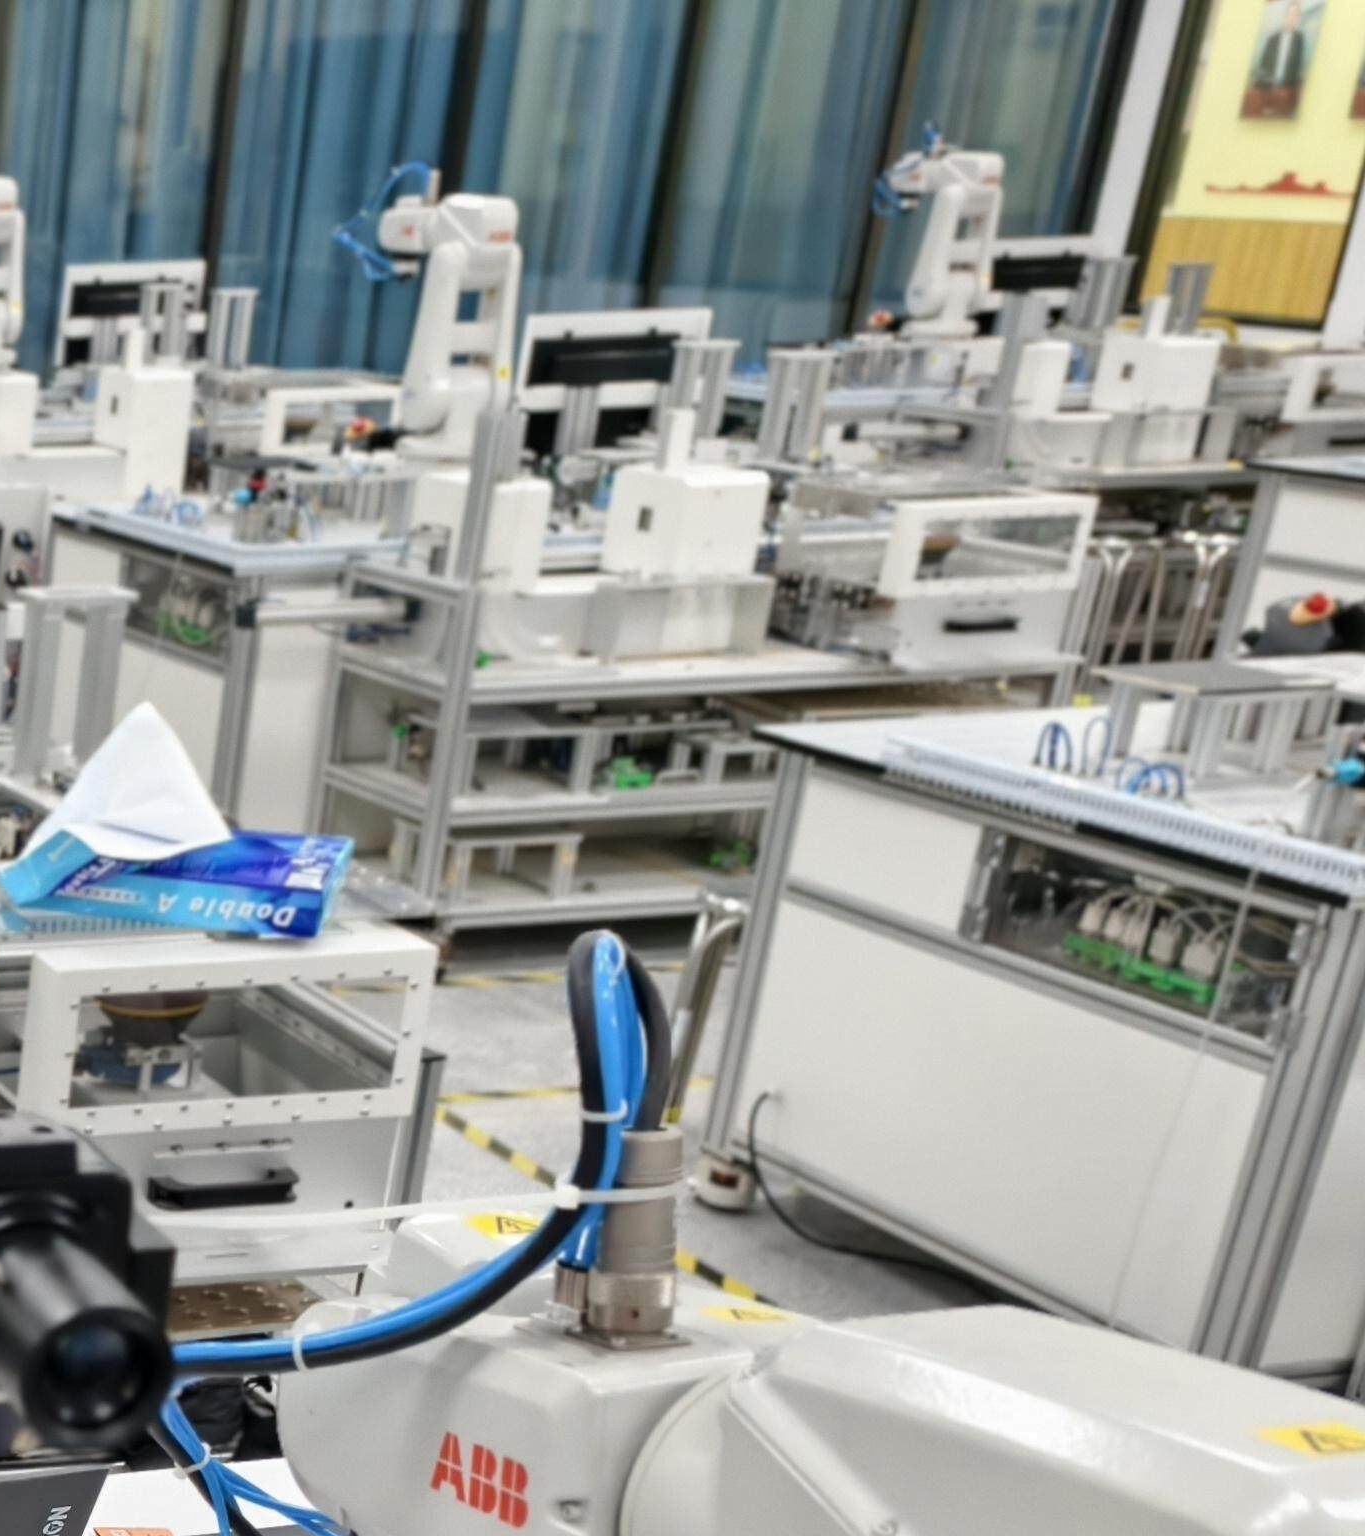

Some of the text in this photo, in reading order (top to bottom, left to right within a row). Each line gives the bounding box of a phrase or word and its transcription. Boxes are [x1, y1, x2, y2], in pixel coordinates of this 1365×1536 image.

[156, 892, 179, 913] A
[189, 896, 297, 928] Double
[430, 1430, 529, 1529] ABB
